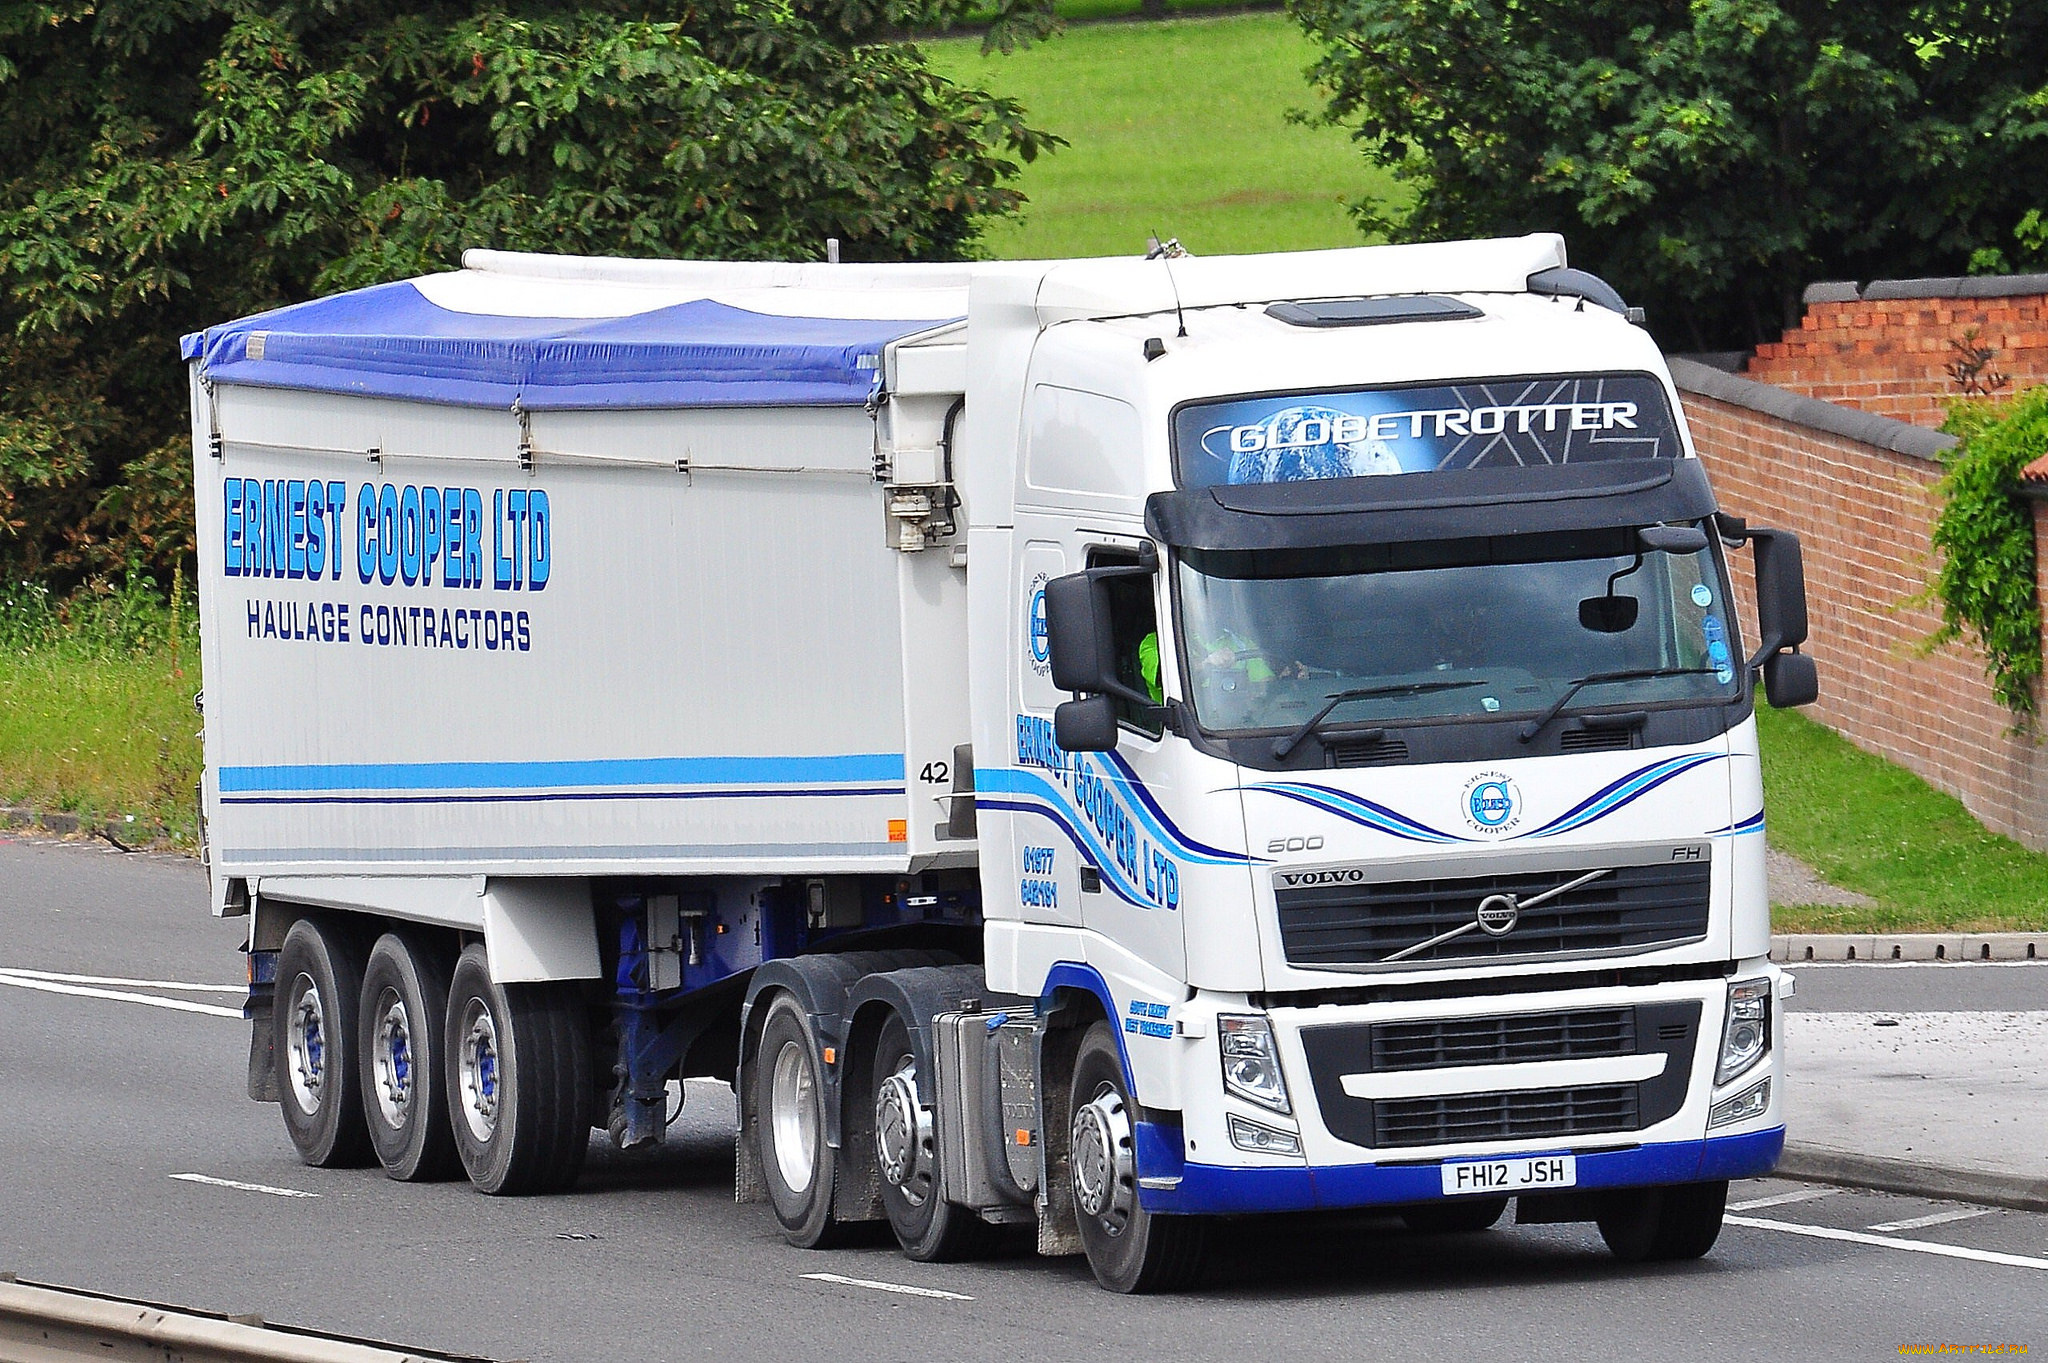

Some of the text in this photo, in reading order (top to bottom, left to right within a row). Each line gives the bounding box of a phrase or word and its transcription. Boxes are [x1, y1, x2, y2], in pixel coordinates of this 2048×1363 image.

[1230, 402, 1639, 452] GLOBETROTTER
[224, 477, 551, 592] ERNEST COOPER LTD
[247, 599, 531, 652] HAULAGE CONTRACTORS
[919, 761, 949, 784] 42
[1074, 750, 1139, 886] COOPER
[1143, 838, 1180, 911] LTD
[1466, 817, 1521, 834] COOPER
[1023, 845, 1056, 875] 01977
[1671, 846, 1701, 861] FH
[1281, 868, 1364, 886] VOLVO
[1480, 911, 1516, 919] VOLVO
[1456, 1159, 1564, 1189] FH12 JSH
